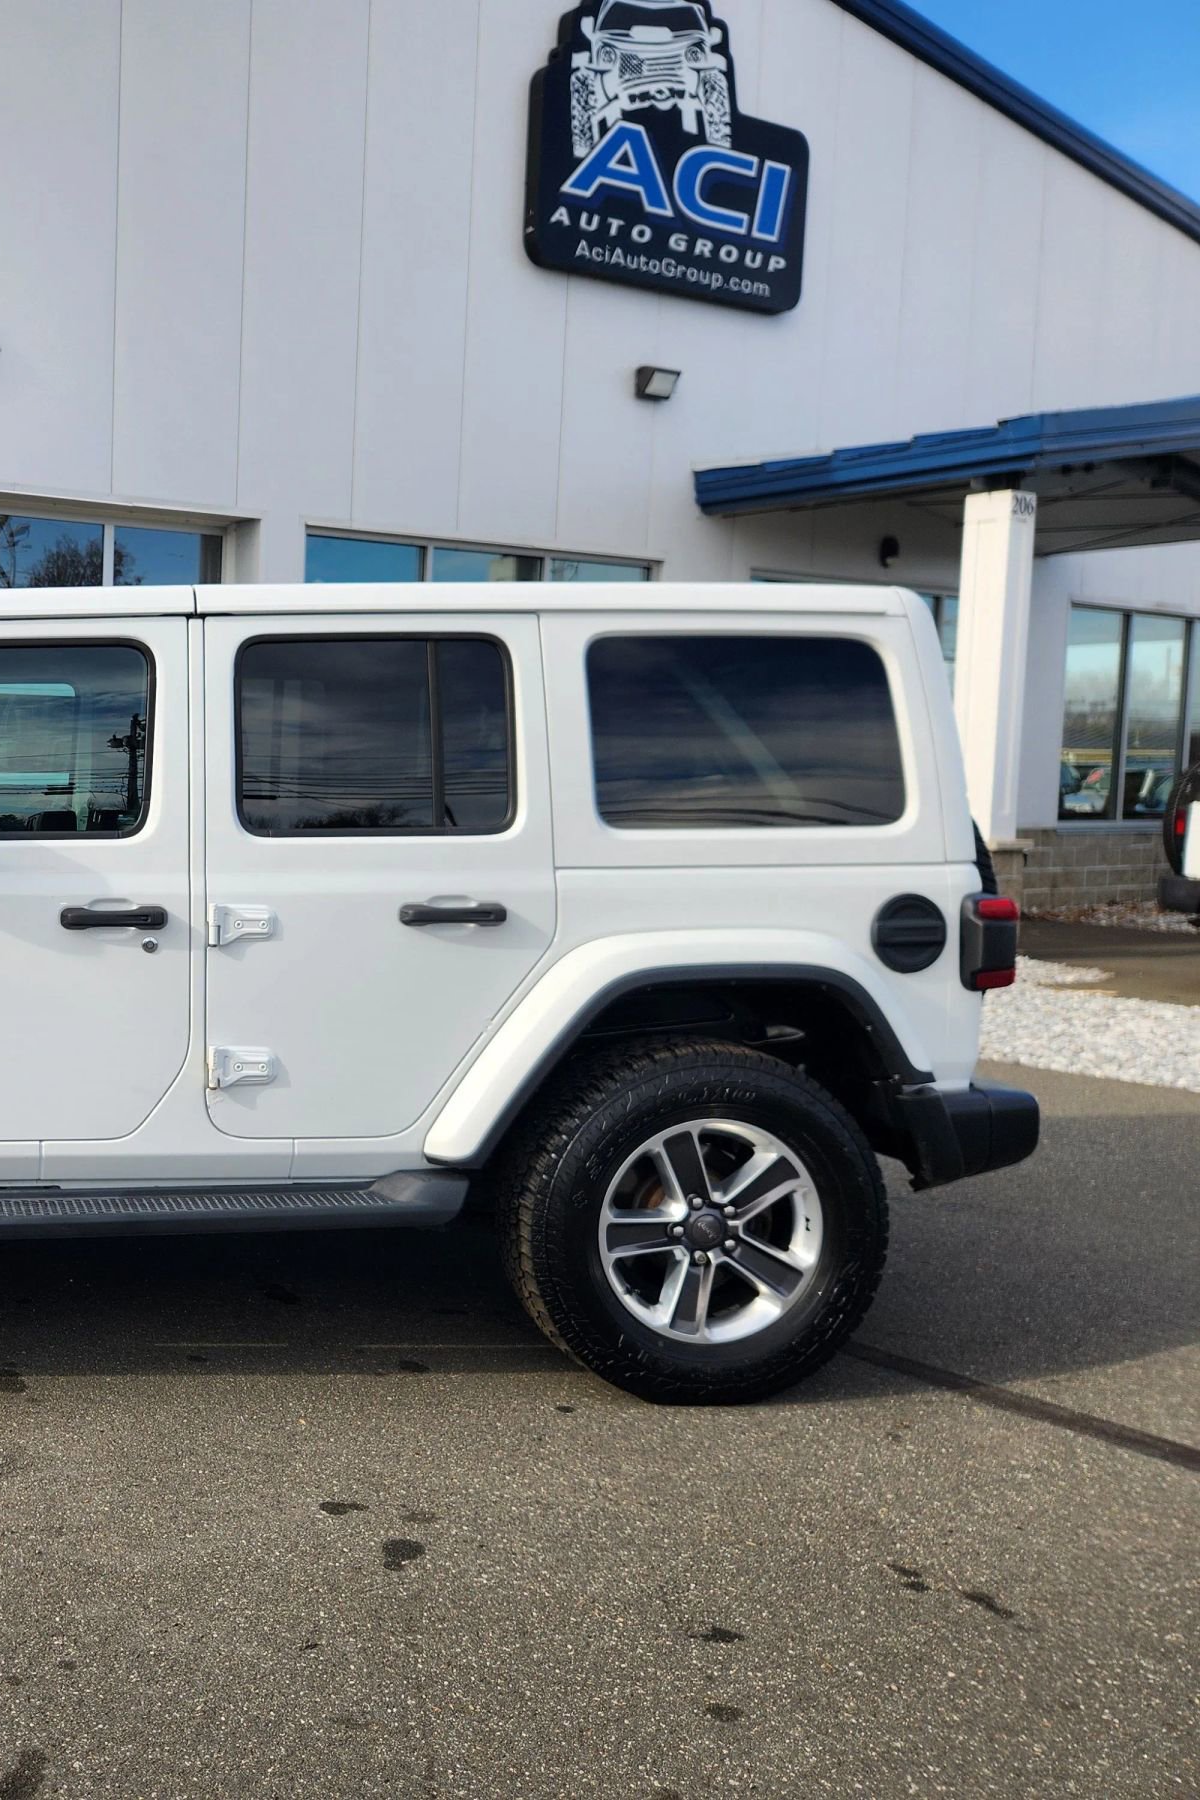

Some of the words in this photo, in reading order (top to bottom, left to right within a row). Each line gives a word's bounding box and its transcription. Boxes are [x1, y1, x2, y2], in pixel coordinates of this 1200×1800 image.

[559, 119, 792, 243] ACI
[550, 205, 653, 244] AUTO
[668, 233, 788, 273] GROUP
[574, 239, 771, 297] AciAutoGroup.com
[1012, 494, 1034, 515] 206
